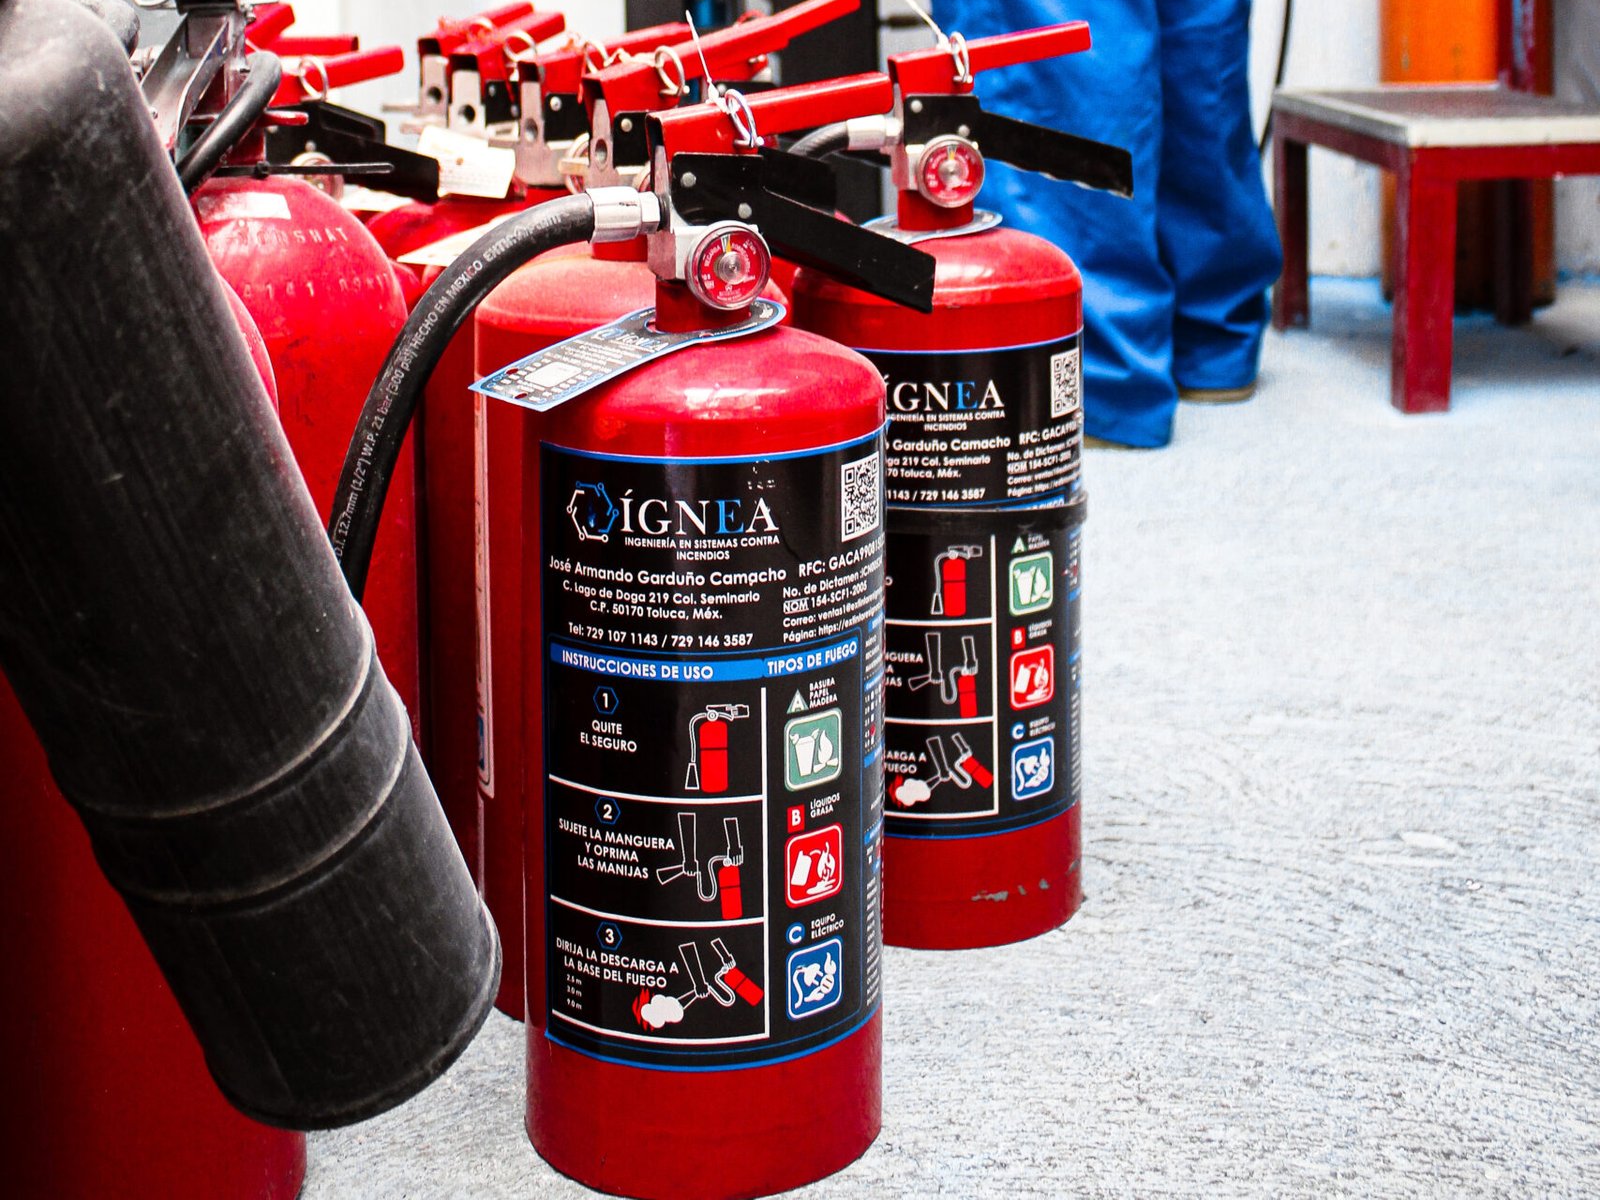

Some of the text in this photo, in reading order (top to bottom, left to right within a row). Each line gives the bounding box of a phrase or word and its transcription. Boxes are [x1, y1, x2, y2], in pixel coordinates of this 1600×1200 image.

[339, 492, 359, 535] 12.7mm
[371, 415, 385, 431] 21
[410, 312, 439, 351] HECHO
[434, 295, 449, 314] EN
[446, 259, 483, 300] MEXICO
[926, 413, 937, 422] EN
[938, 412, 973, 422] SISTEMAS
[974, 410, 1005, 420] CONTRA
[924, 422, 967, 431] INCENDIOS
[893, 439, 948, 451] Garduño
[950, 435, 1011, 451] Camacho
[1019, 430, 1040, 445] RFC:
[887, 455, 991, 467] ga 219 Col. Seminario
[900, 468, 935, 479] Toluca,
[937, 467, 962, 478] Méx.
[887, 489, 910, 500] 1143
[920, 490, 939, 500] 729
[941, 489, 959, 500] 146
[961, 488, 986, 500] 3587
[619, 489, 779, 535] ÍGNEA
[625, 535, 780, 549] INGENIERÍA EN SISTEMAS CONTRA
[676, 550, 730, 560] INCENDIOS
[549, 555, 787, 586] José Armando Garduño Camacho
[798, 560, 826, 578] RFC:
[563, 579, 760, 605] C. Lago de Doga 219 Col. Seminario
[783, 586, 801, 598] No.
[804, 583, 817, 595] de
[819, 572, 859, 592] Dictamen
[590, 600, 723, 620] C.P. 50170 Toluca, Méx.
[783, 600, 808, 613] NOM
[783, 615, 816, 628] Correo:
[568, 622, 753, 648] Tel: 729 107 1143 / 729 146 3587
[783, 627, 817, 643] Página:
[1014, 629, 1022, 645] B
[562, 650, 714, 680] INSTRUCCIONES DE USO
[767, 656, 804, 675] TIPOS
[807, 652, 822, 669] DE
[825, 641, 857, 664] FUEGO
[809, 677, 836, 691] BASURA
[602, 692, 609, 708] 1
[591, 720, 623, 735] QUITE
[1012, 724, 1024, 740] C
[580, 731, 637, 753] EL SEGURO
[886, 750, 927, 762] ARGA A
[810, 792, 840, 810] LÍQUIDOS
[603, 804, 613, 820] 2
[791, 809, 801, 827] B
[810, 804, 834, 818] GRASA
[559, 818, 675, 851] SUJETE LA MANGUERA
[585, 841, 639, 863] Y OPRIMA
[577, 854, 649, 879] LAS MANIJAS
[811, 913, 836, 929] EQUIPO
[605, 928, 615, 944] 3
[788, 925, 802, 944] C
[556, 937, 679, 974] DIRIJA LA DESCARGA A
[564, 955, 667, 988] LA BASE DEL FUEGO
[575, 978, 582, 986] m
[575, 1002, 582, 1010] m
